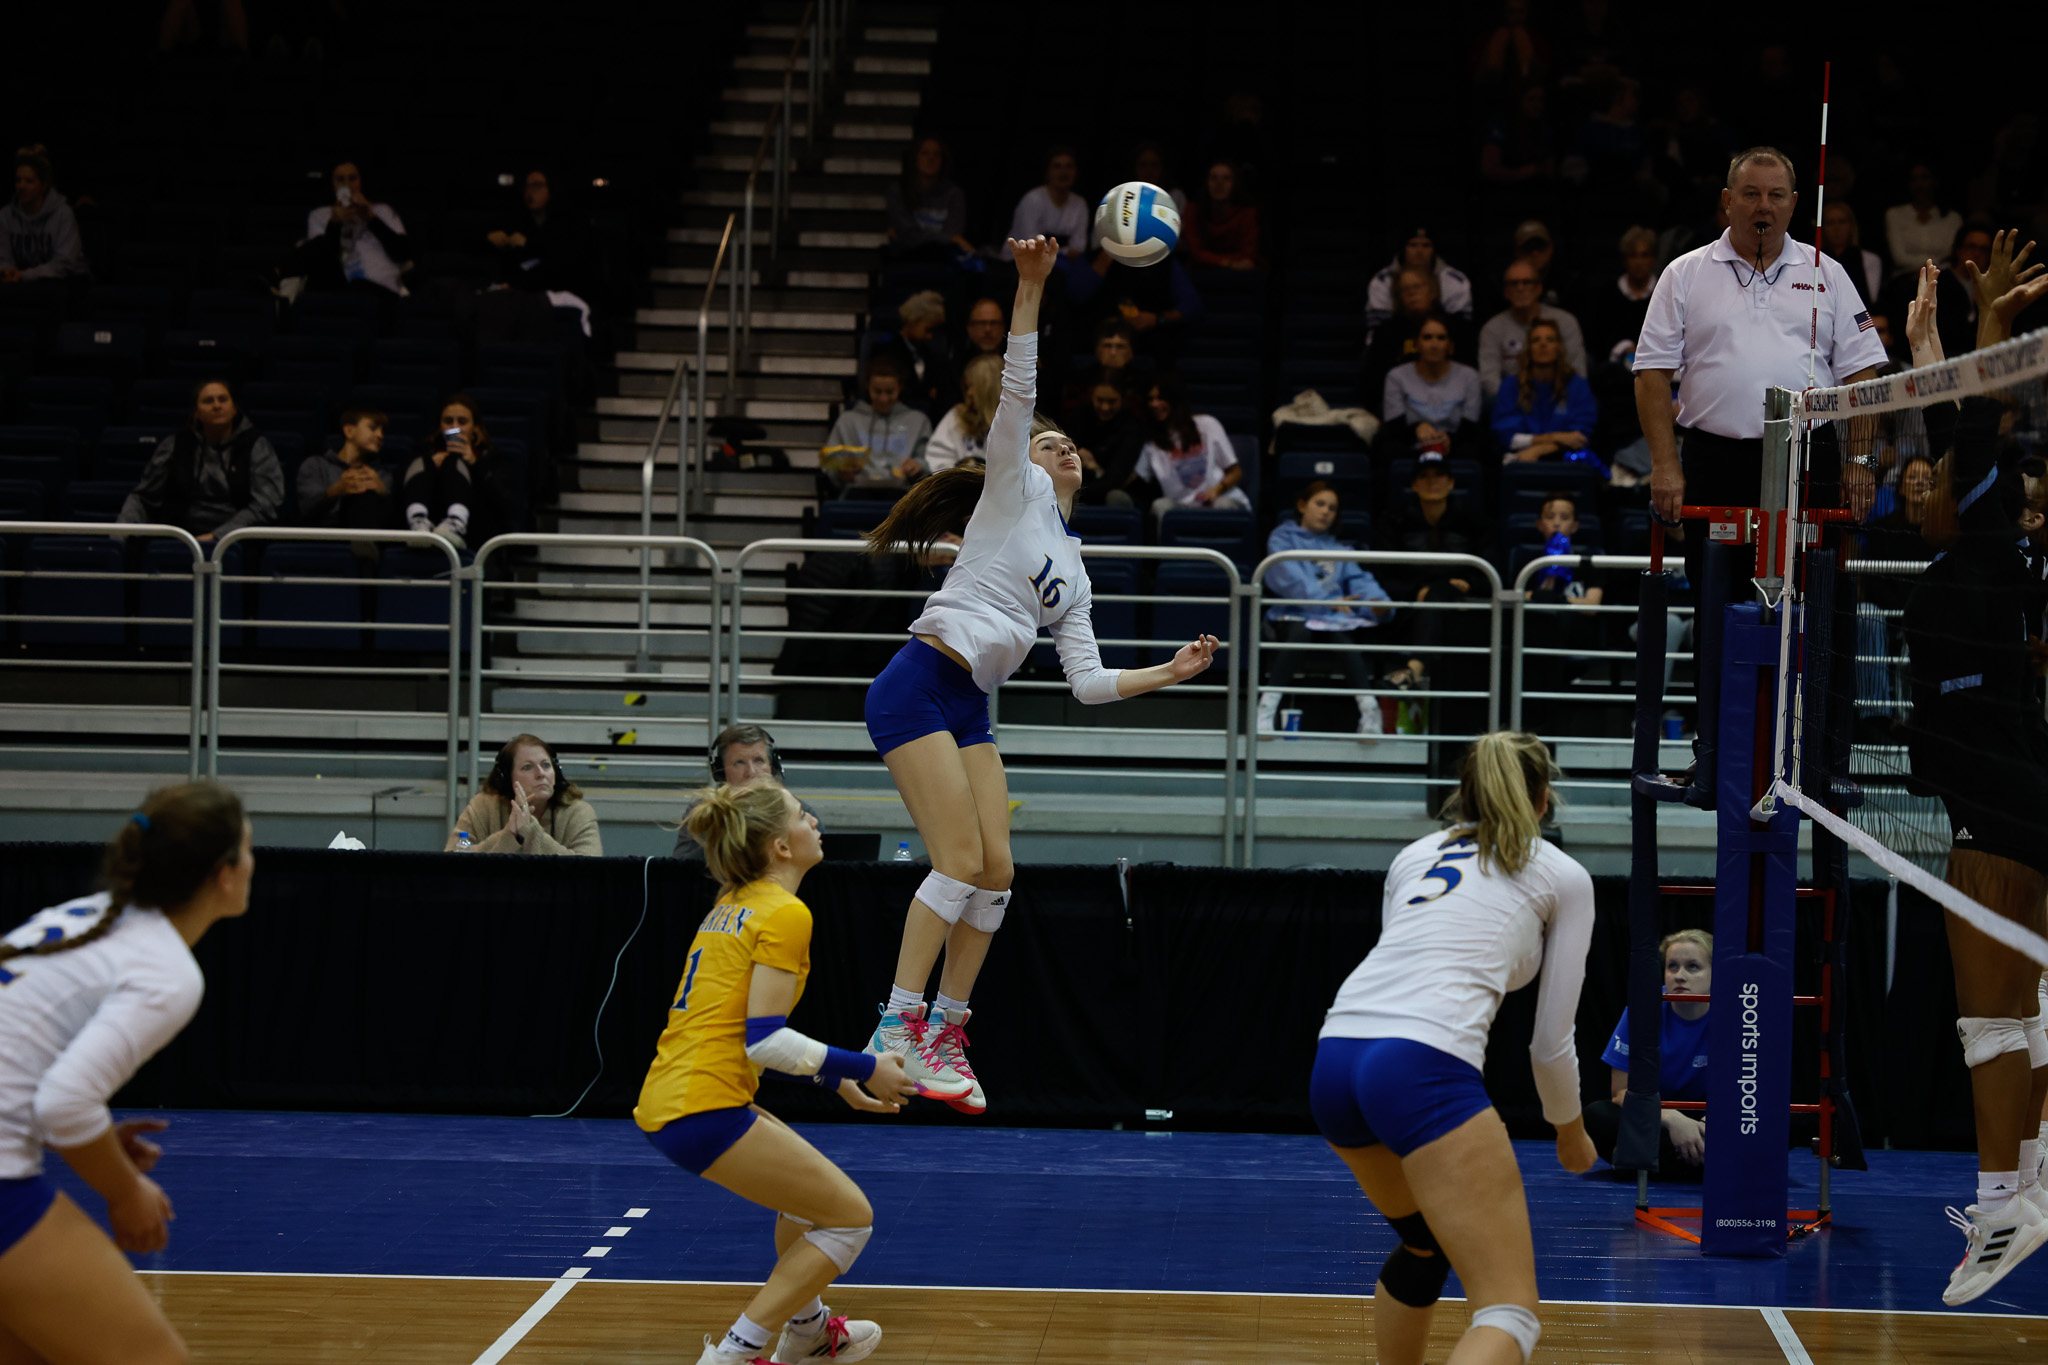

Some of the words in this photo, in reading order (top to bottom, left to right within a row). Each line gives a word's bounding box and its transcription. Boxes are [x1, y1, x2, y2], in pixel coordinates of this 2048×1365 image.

[1028, 553, 1068, 608] 16
[1407, 851, 1480, 905] 5
[671, 946, 705, 1012] 1
[1738, 983, 1761, 1050] sports
[1737, 1053, 1760, 1135] imports
[1715, 1218, 1777, 1229] (800)556-3198
